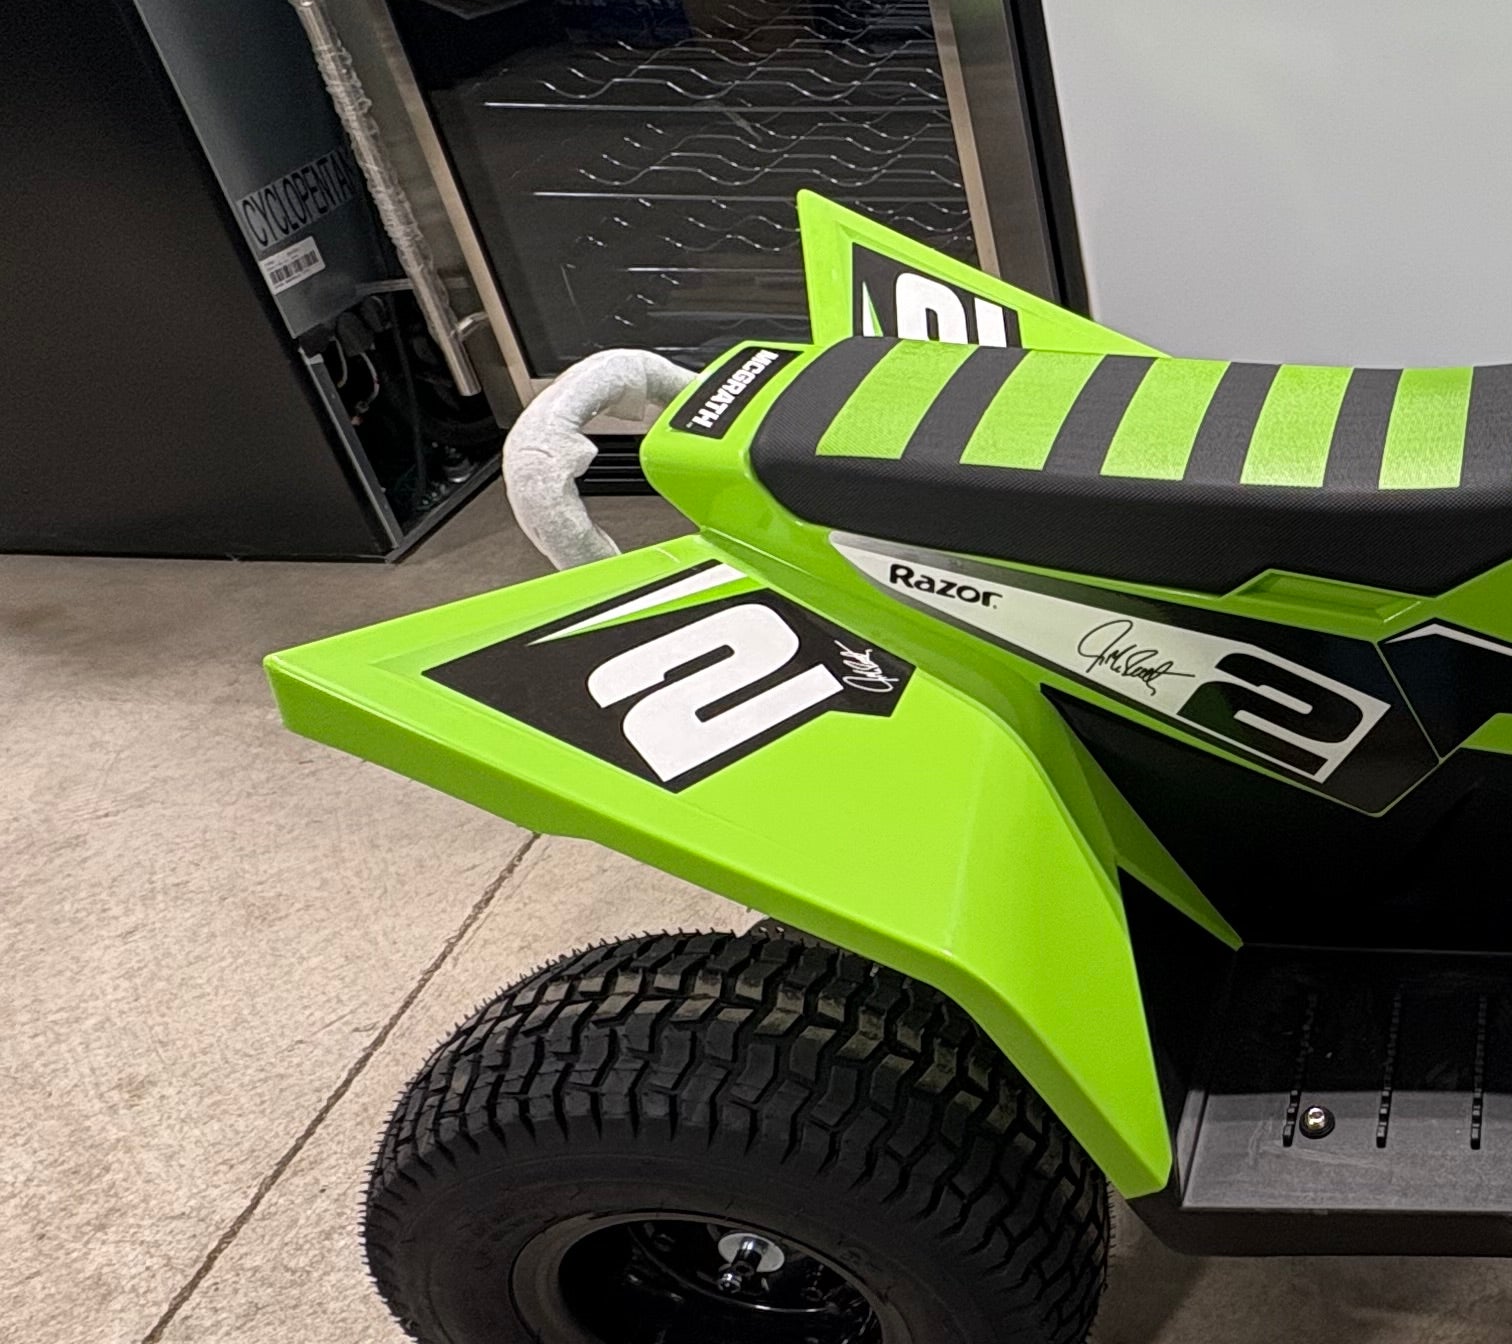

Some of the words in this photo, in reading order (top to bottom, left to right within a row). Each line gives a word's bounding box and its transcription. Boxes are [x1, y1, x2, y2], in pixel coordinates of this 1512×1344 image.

[889, 563, 1003, 608] Razor
[587, 603, 844, 783] 2
[1176, 652, 1364, 777] 2
